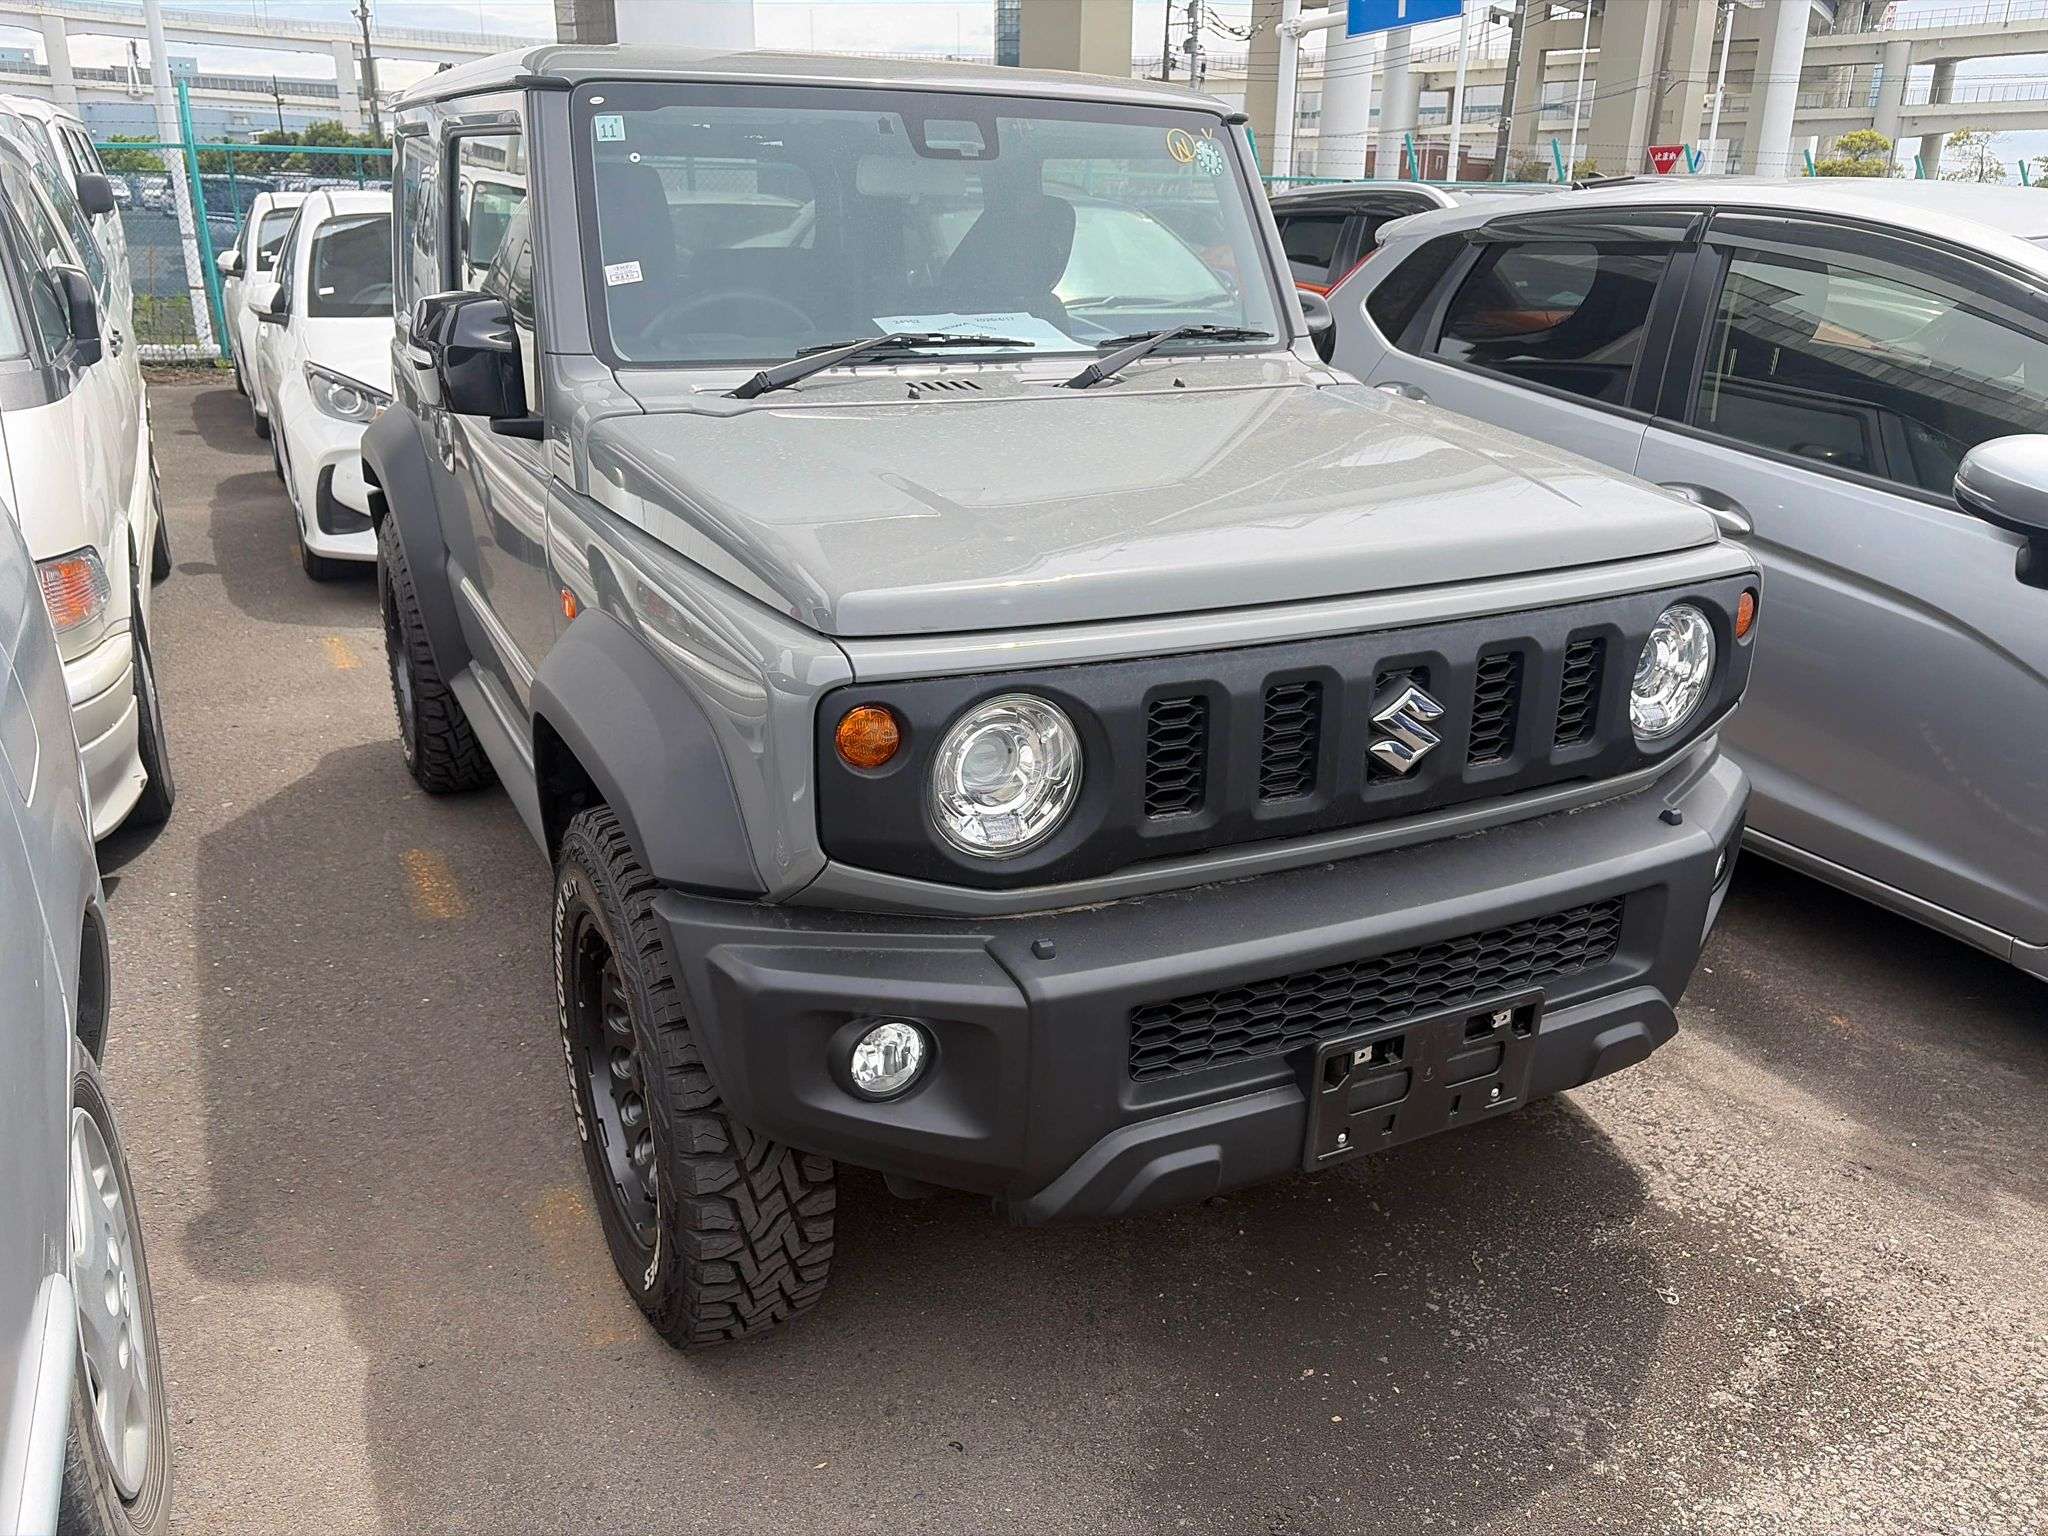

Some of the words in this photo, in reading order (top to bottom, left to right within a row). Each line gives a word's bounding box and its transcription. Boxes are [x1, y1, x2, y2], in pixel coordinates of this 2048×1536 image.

[601, 124, 617, 138] 11
[1654, 151, 1677, 161] 止まれ
[554, 892, 568, 1030] COUNTRY
[563, 1033, 588, 1142] OPEN
